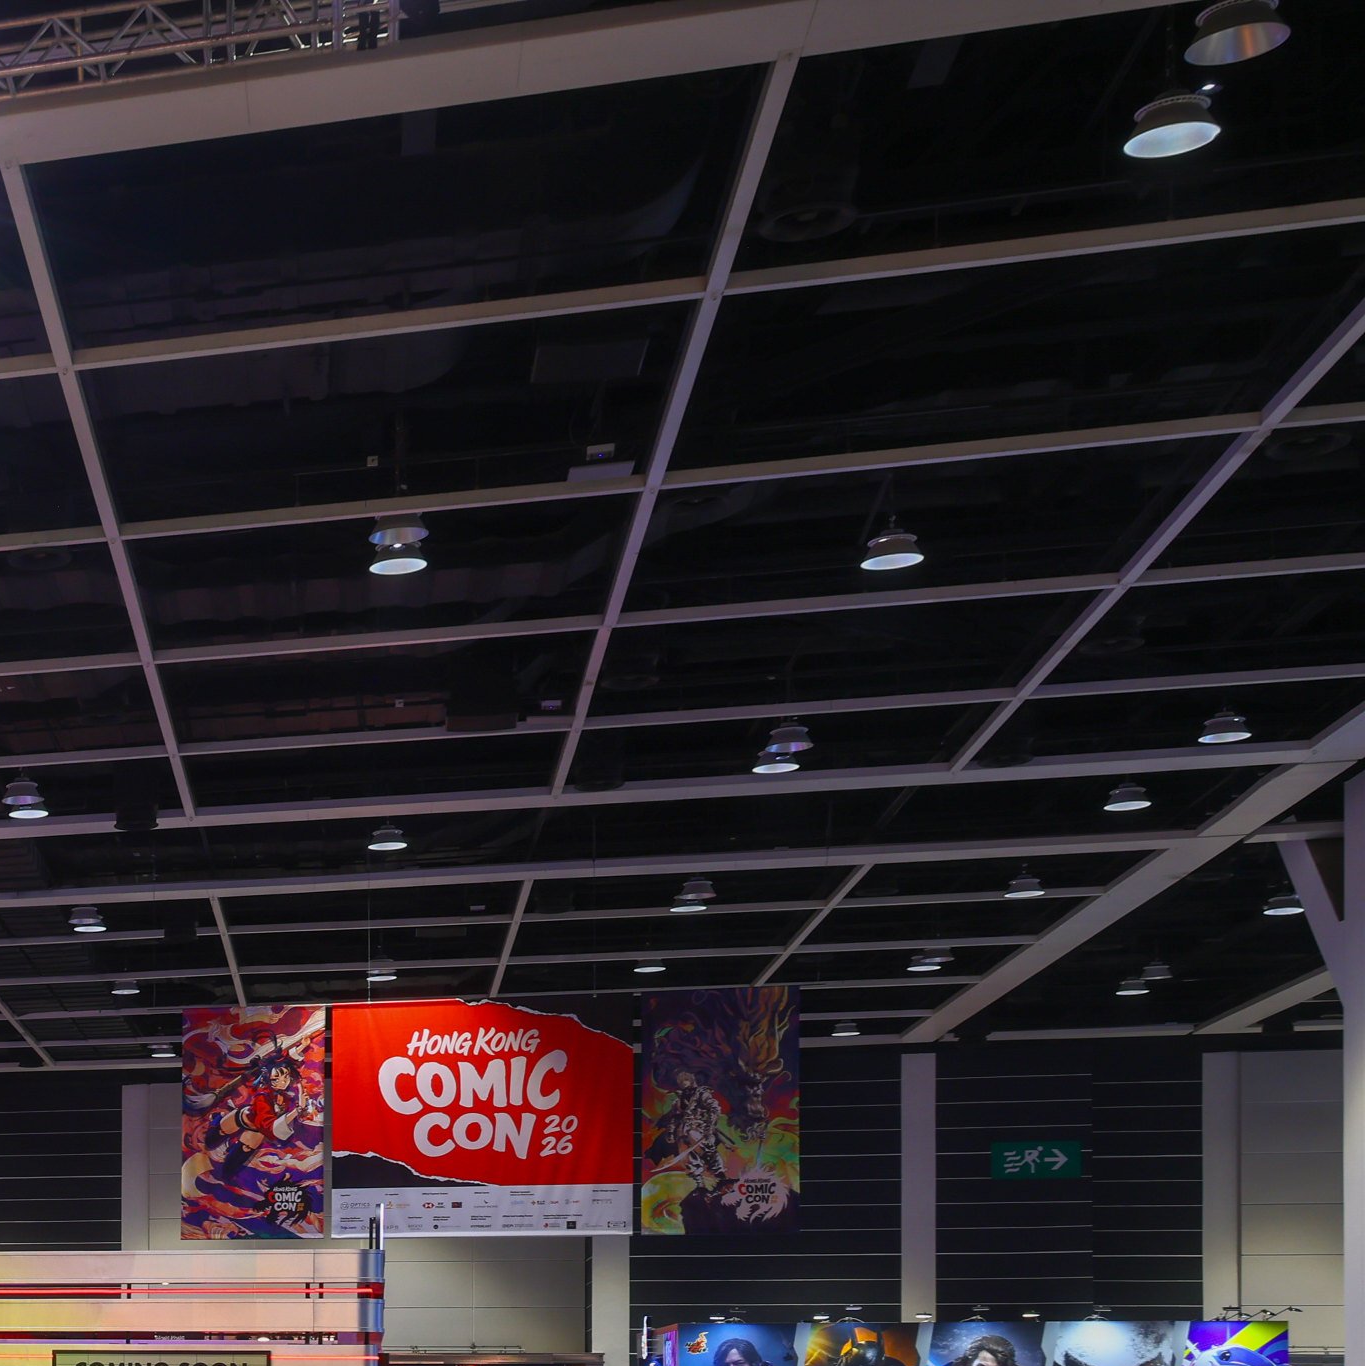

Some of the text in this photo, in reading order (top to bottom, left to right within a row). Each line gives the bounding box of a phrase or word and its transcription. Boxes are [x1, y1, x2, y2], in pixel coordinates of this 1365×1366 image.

[406, 1027, 541, 1057] HONG KONG
[378, 1049, 568, 1115] COMIC
[543, 1114, 579, 1135] 20
[413, 1111, 537, 1160] CON
[539, 1134, 573, 1157] 26
[268, 1190, 303, 1203] COMIC
[738, 1182, 777, 1196] COMIC
[745, 1194, 770, 1204] CON
[274, 1202, 297, 1212] CON
